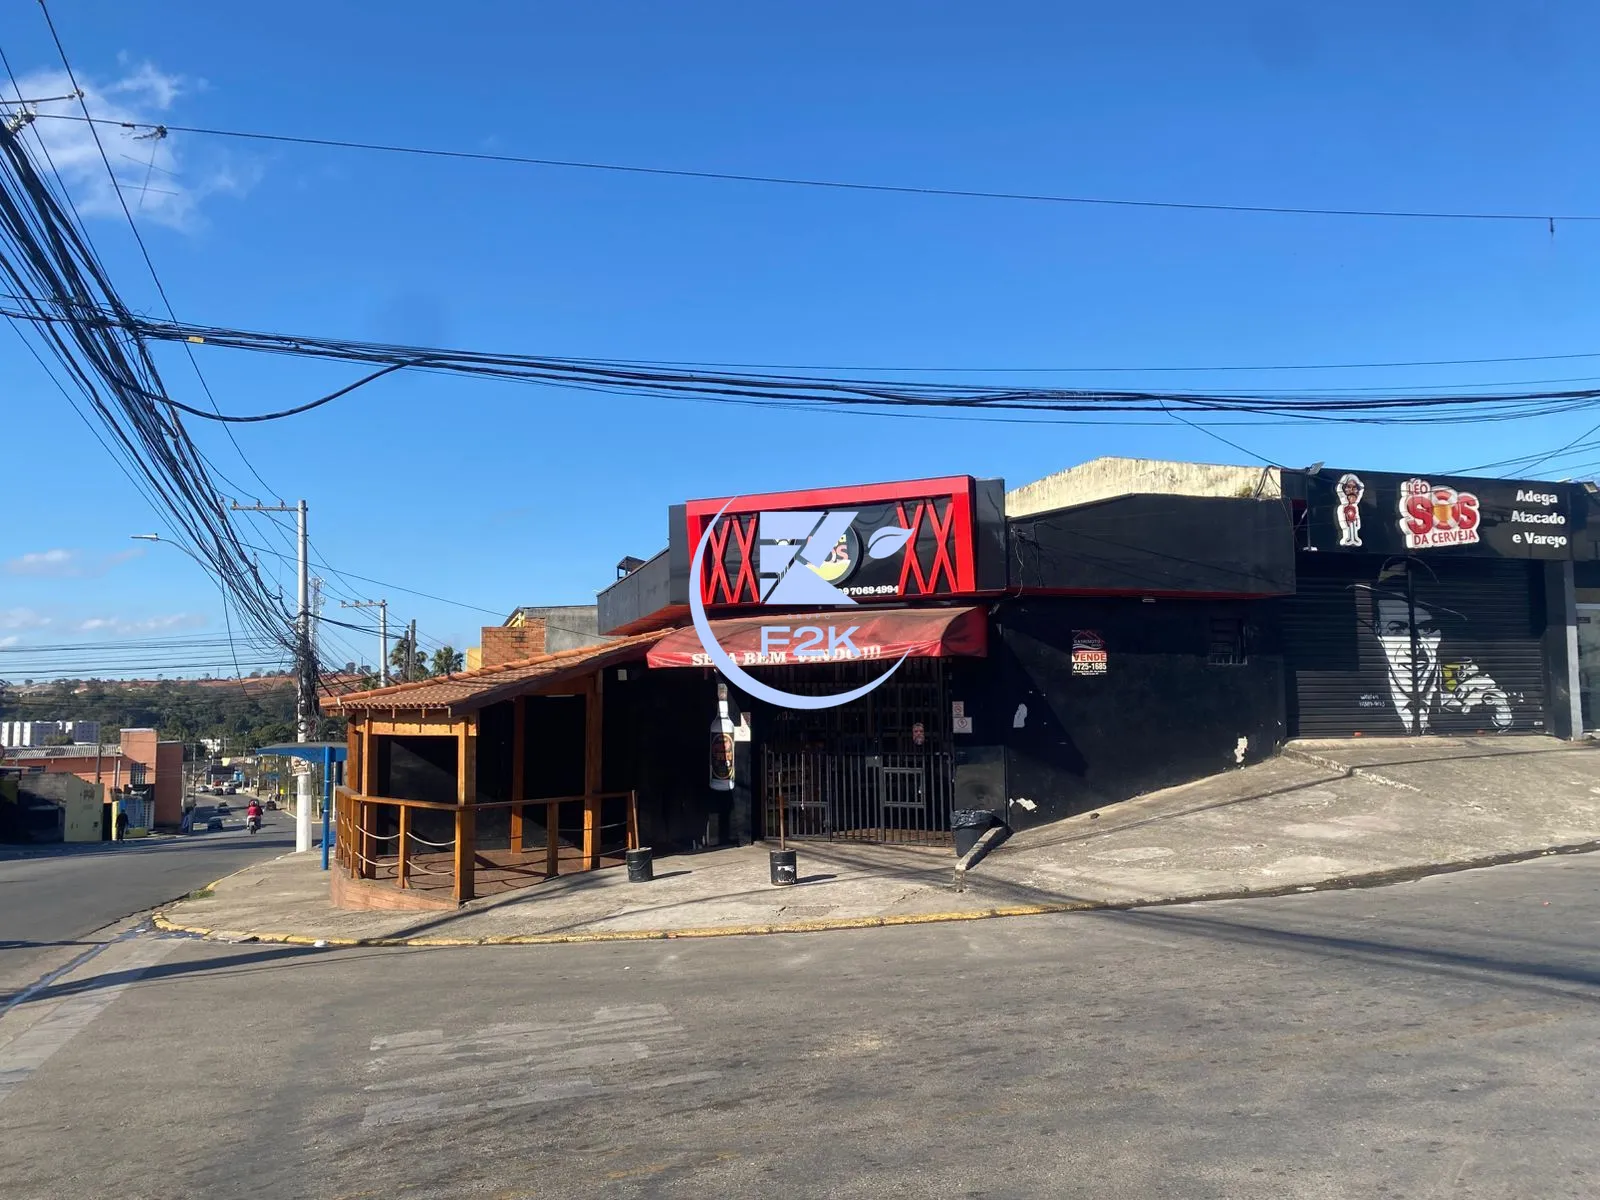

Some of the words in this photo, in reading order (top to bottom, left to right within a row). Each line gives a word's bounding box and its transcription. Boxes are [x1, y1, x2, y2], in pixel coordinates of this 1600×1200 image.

[1516, 489, 1558, 506] Adega
[1511, 510, 1566, 525] Atacado
[1414, 535, 1429, 546] DA
[1431, 530, 1477, 544] CERVEJA
[1512, 534, 1522, 544] e
[1524, 532, 1567, 549] Varejo
[691, 652, 737, 666] SEA
[743, 651, 788, 666] BEM
[1073, 653, 1106, 662] VENDE
